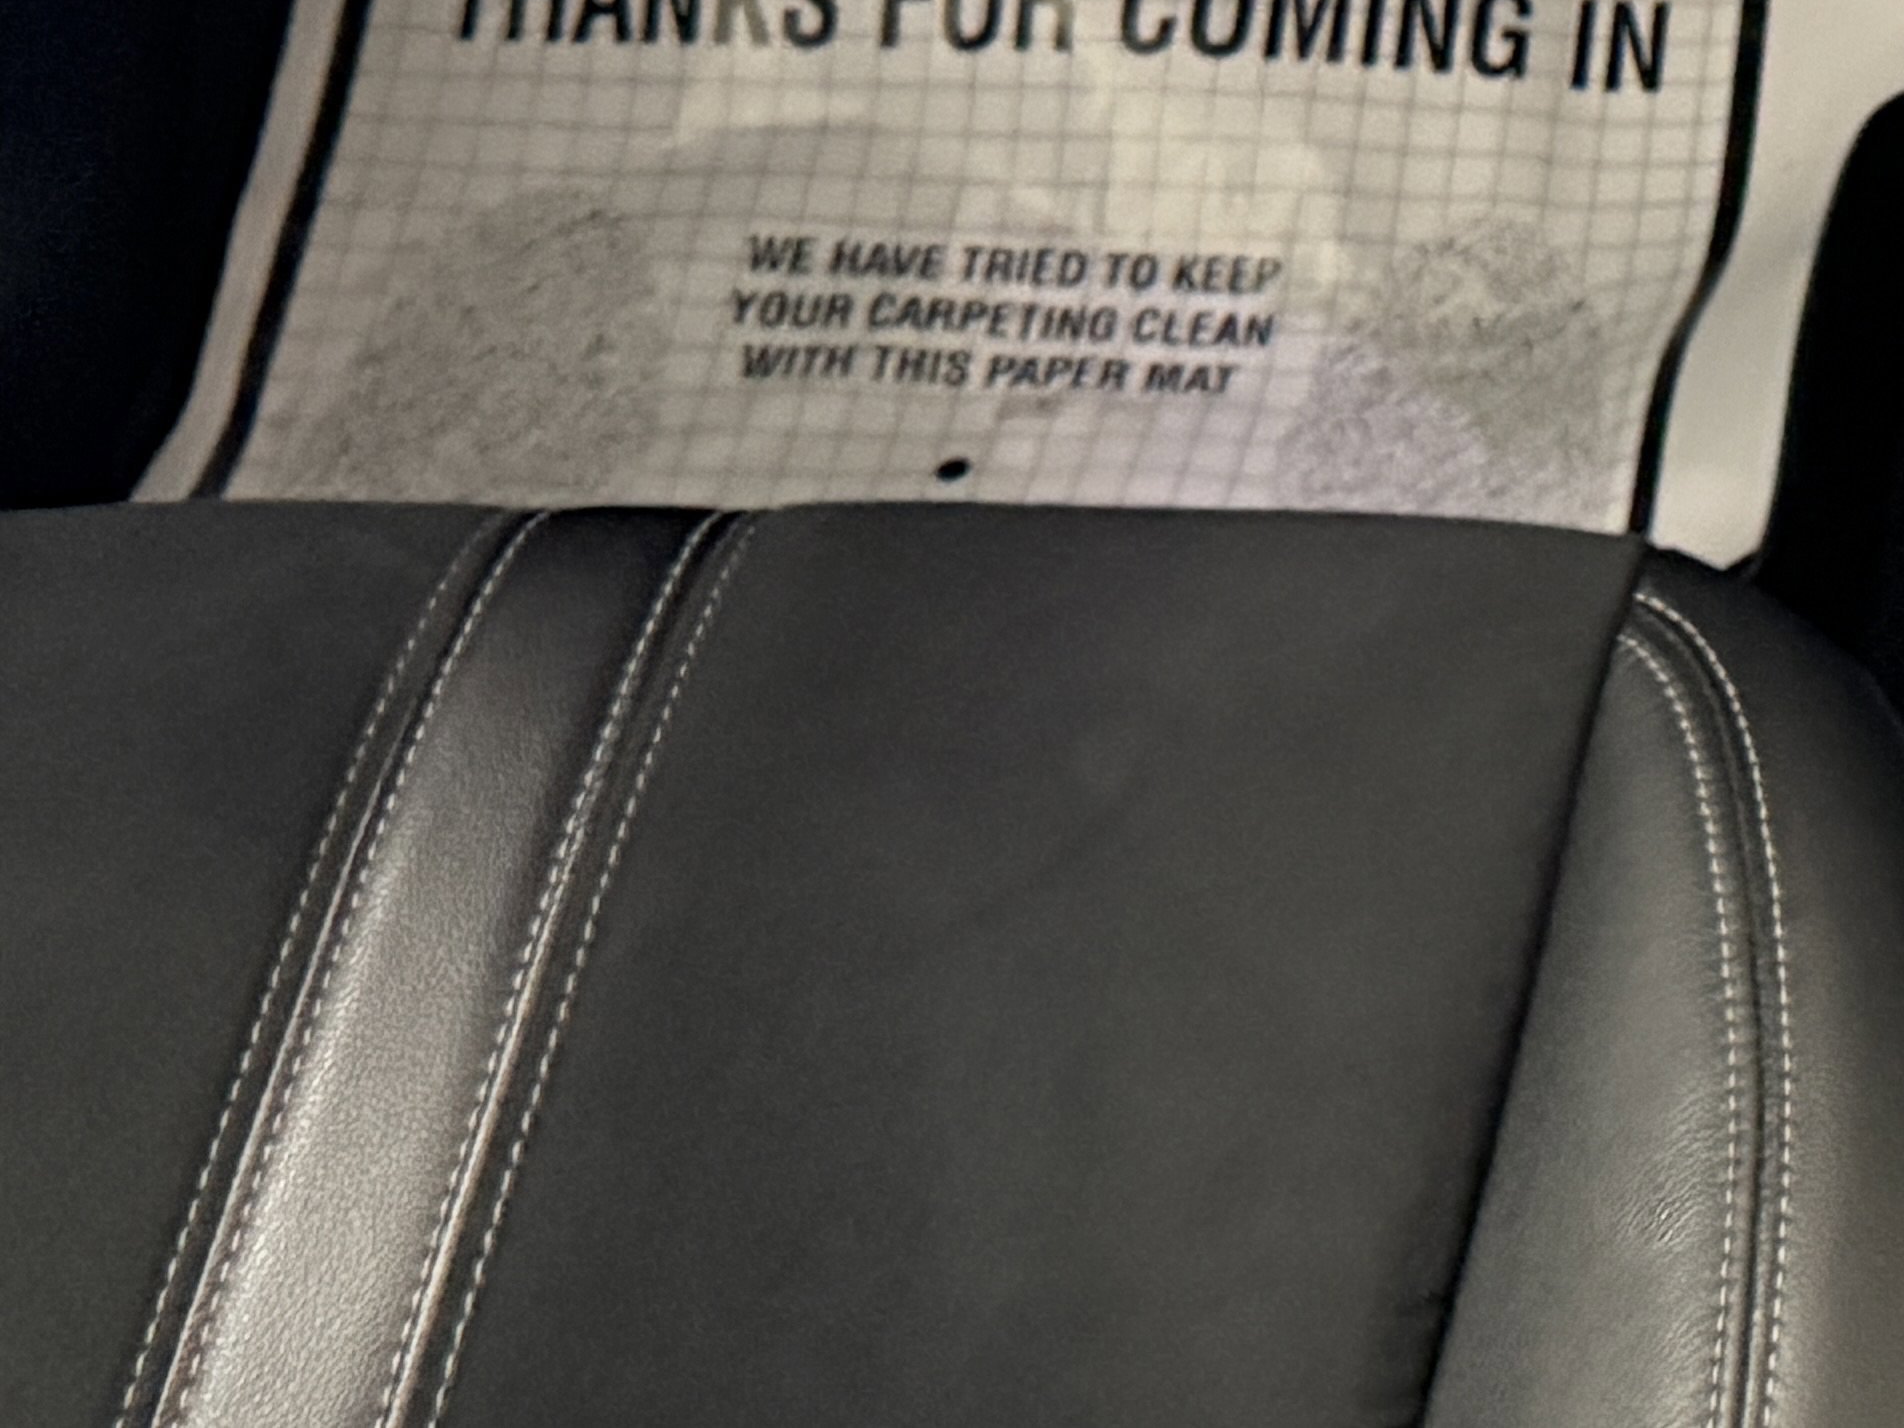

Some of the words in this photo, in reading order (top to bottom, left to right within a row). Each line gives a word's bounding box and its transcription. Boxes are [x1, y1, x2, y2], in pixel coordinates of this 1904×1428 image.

[748, 233, 820, 276] WE
[827, 238, 951, 282] HAVE
[959, 244, 1088, 288] TRIED
[1105, 250, 1161, 292] TO
[1170, 254, 1284, 296] KEEP
[729, 286, 854, 329] YOUR
[867, 292, 1119, 343] CARPETING
[1131, 306, 1277, 348] CLEAN
[742, 343, 857, 382] WITH
[873, 346, 973, 388] THIS
[981, 351, 1132, 392] PAPER
[1143, 358, 1242, 396] MAT
